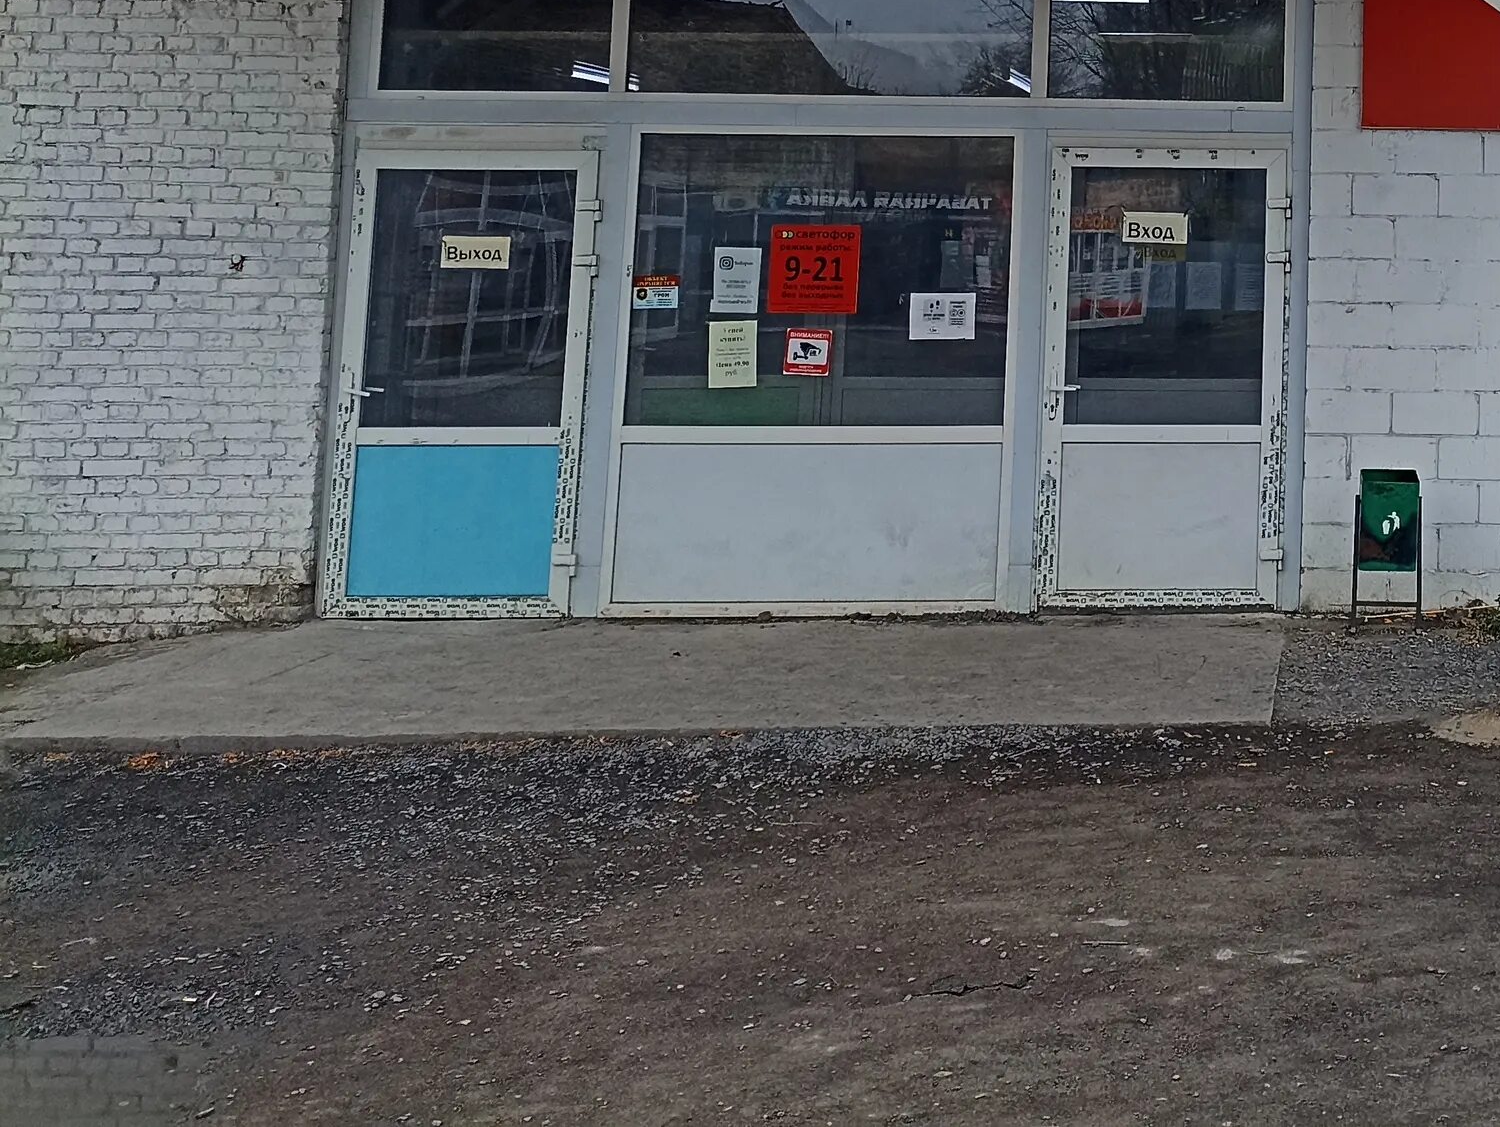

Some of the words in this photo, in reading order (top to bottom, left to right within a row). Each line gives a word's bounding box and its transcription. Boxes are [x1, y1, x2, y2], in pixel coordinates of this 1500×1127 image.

[796, 230, 855, 241] светофор
[1127, 222, 1175, 242] Вход
[447, 246, 502, 262] Выход
[784, 256, 844, 282] 9-21
